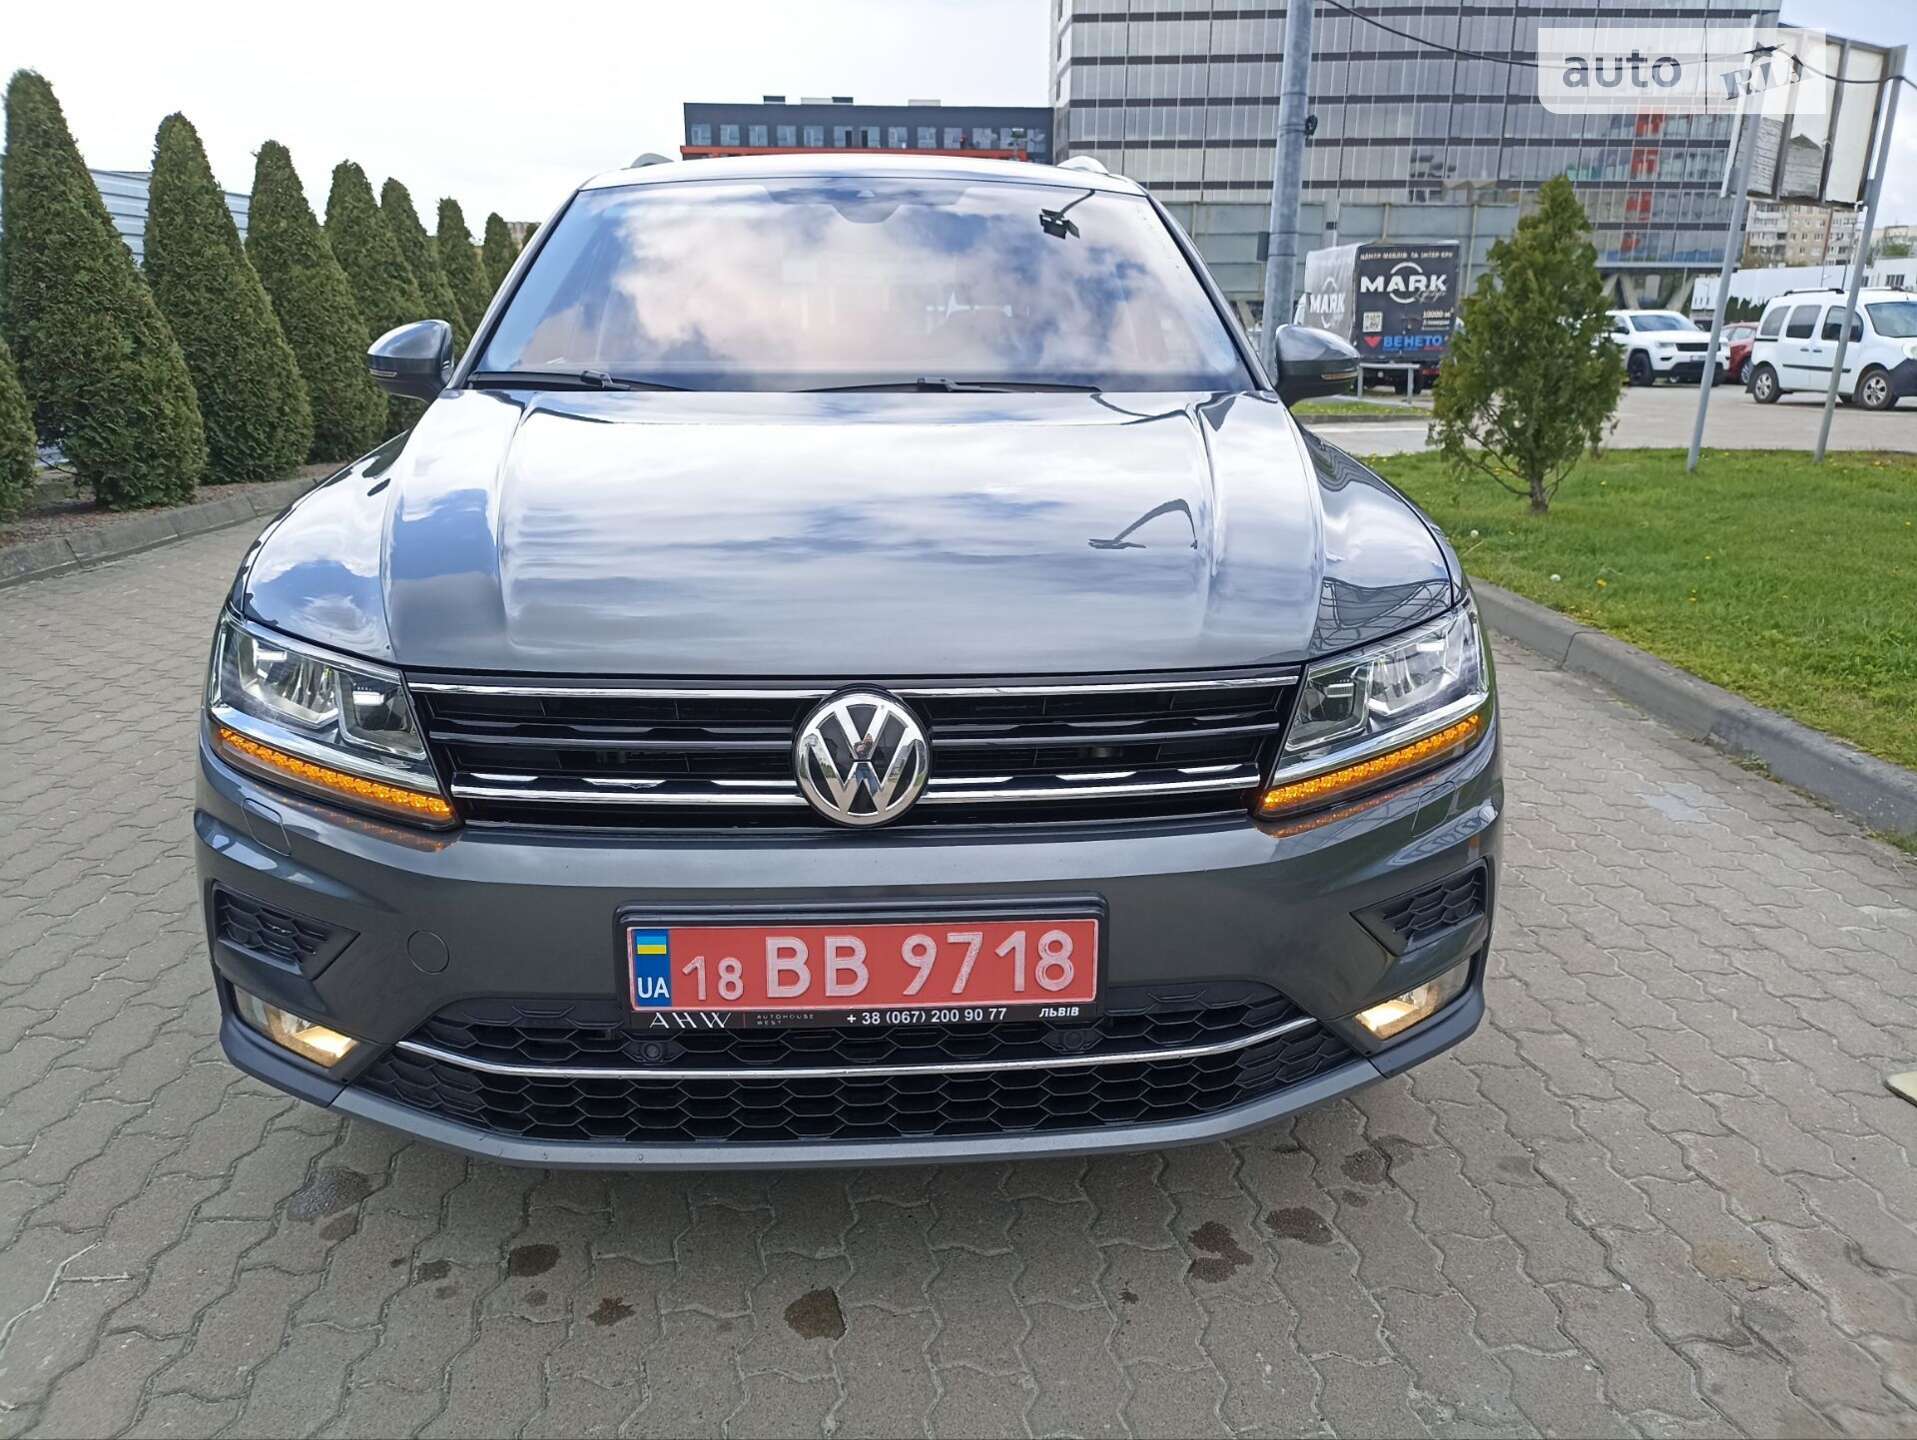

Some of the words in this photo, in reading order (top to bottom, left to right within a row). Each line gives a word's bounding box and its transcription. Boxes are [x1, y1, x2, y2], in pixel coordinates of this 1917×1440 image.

[1360, 274, 1447, 293] MARK
[1310, 293, 1345, 313] MARK
[682, 955, 745, 1001] 18
[765, 935, 871, 998] BB
[901, 929, 1076, 997] 9718
[637, 977, 670, 999] UA
[649, 1012, 731, 1029] AHW
[862, 1011, 881, 1025] 38
[885, 1010, 926, 1025] (067)
[931, 1009, 960, 1023] 200
[964, 1008, 983, 1022] 90
[988, 1007, 1007, 1021] 77
